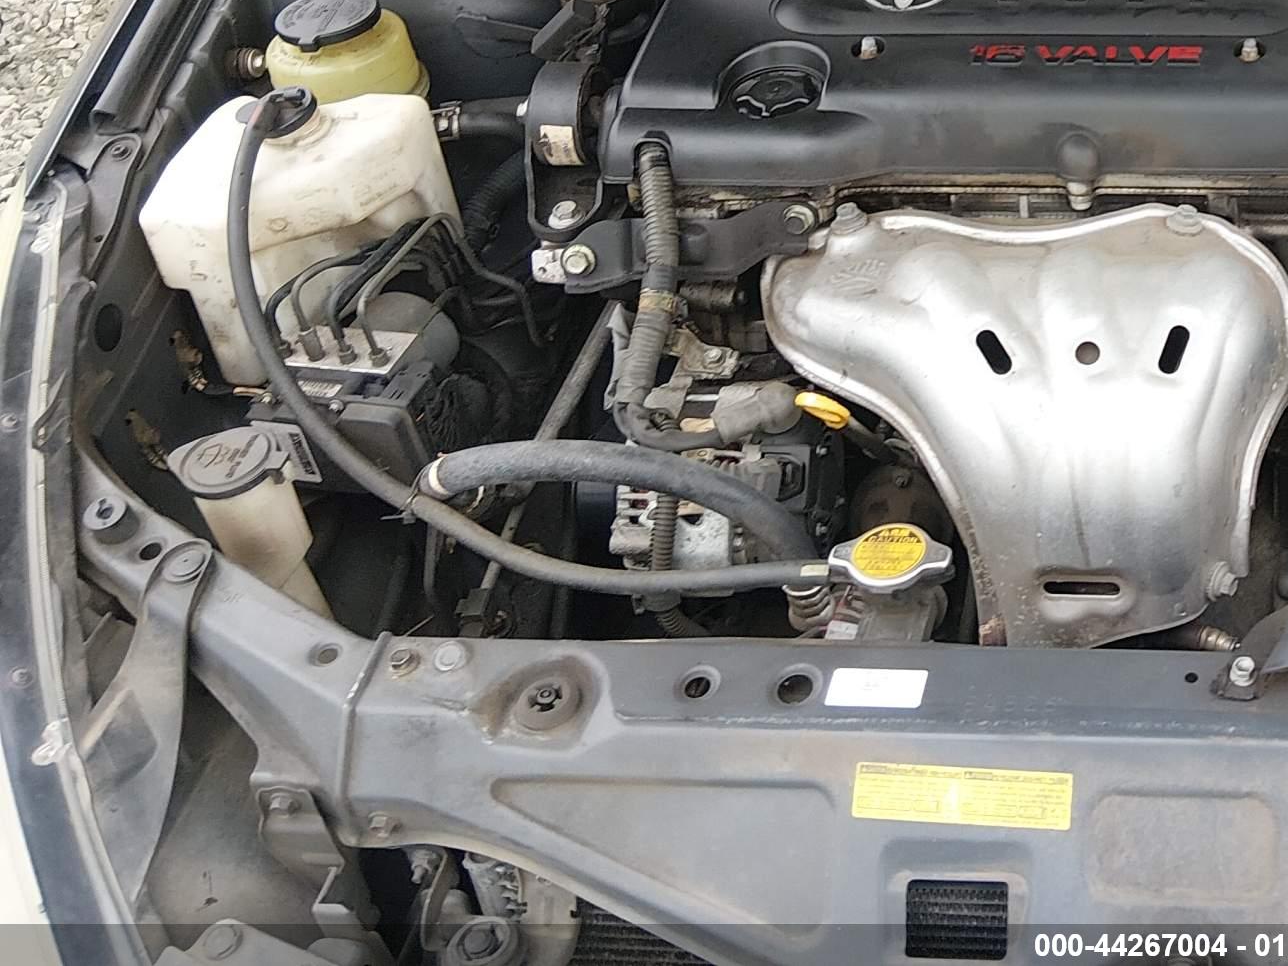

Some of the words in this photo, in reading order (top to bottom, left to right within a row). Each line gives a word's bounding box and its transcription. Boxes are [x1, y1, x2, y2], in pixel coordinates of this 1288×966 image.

[970, 44, 1026, 66] 16
[1036, 44, 1202, 66] VALVE
[867, 535, 919, 544] CAUTION
